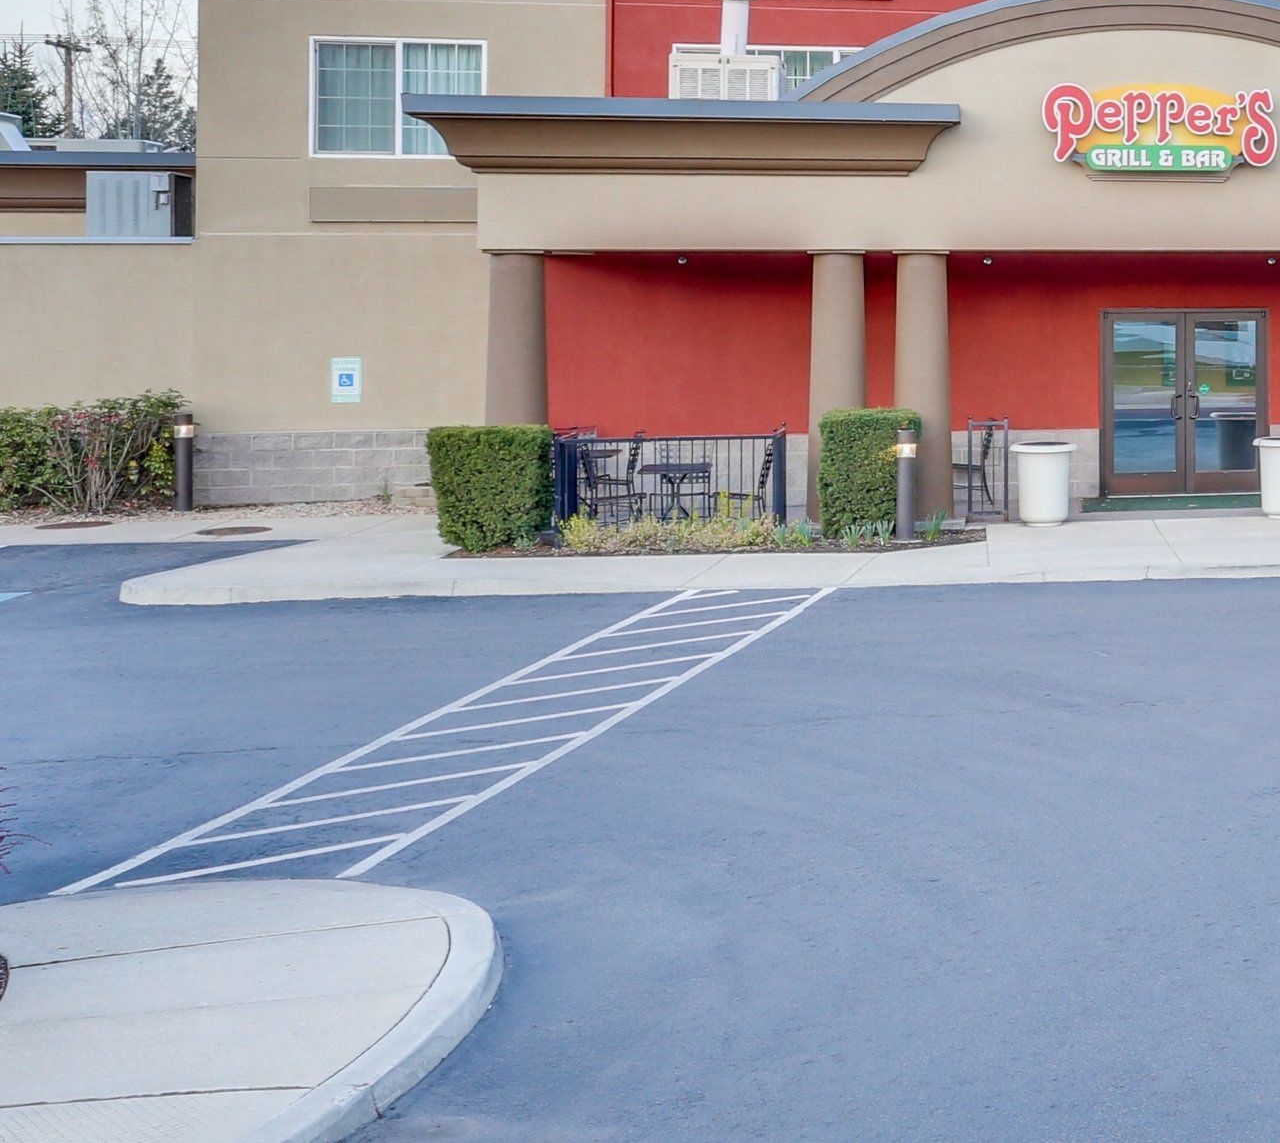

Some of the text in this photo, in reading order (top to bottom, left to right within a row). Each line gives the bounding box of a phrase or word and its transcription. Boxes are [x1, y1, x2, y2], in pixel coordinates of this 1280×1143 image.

[1090, 148, 1228, 169] GRILL & BAR
